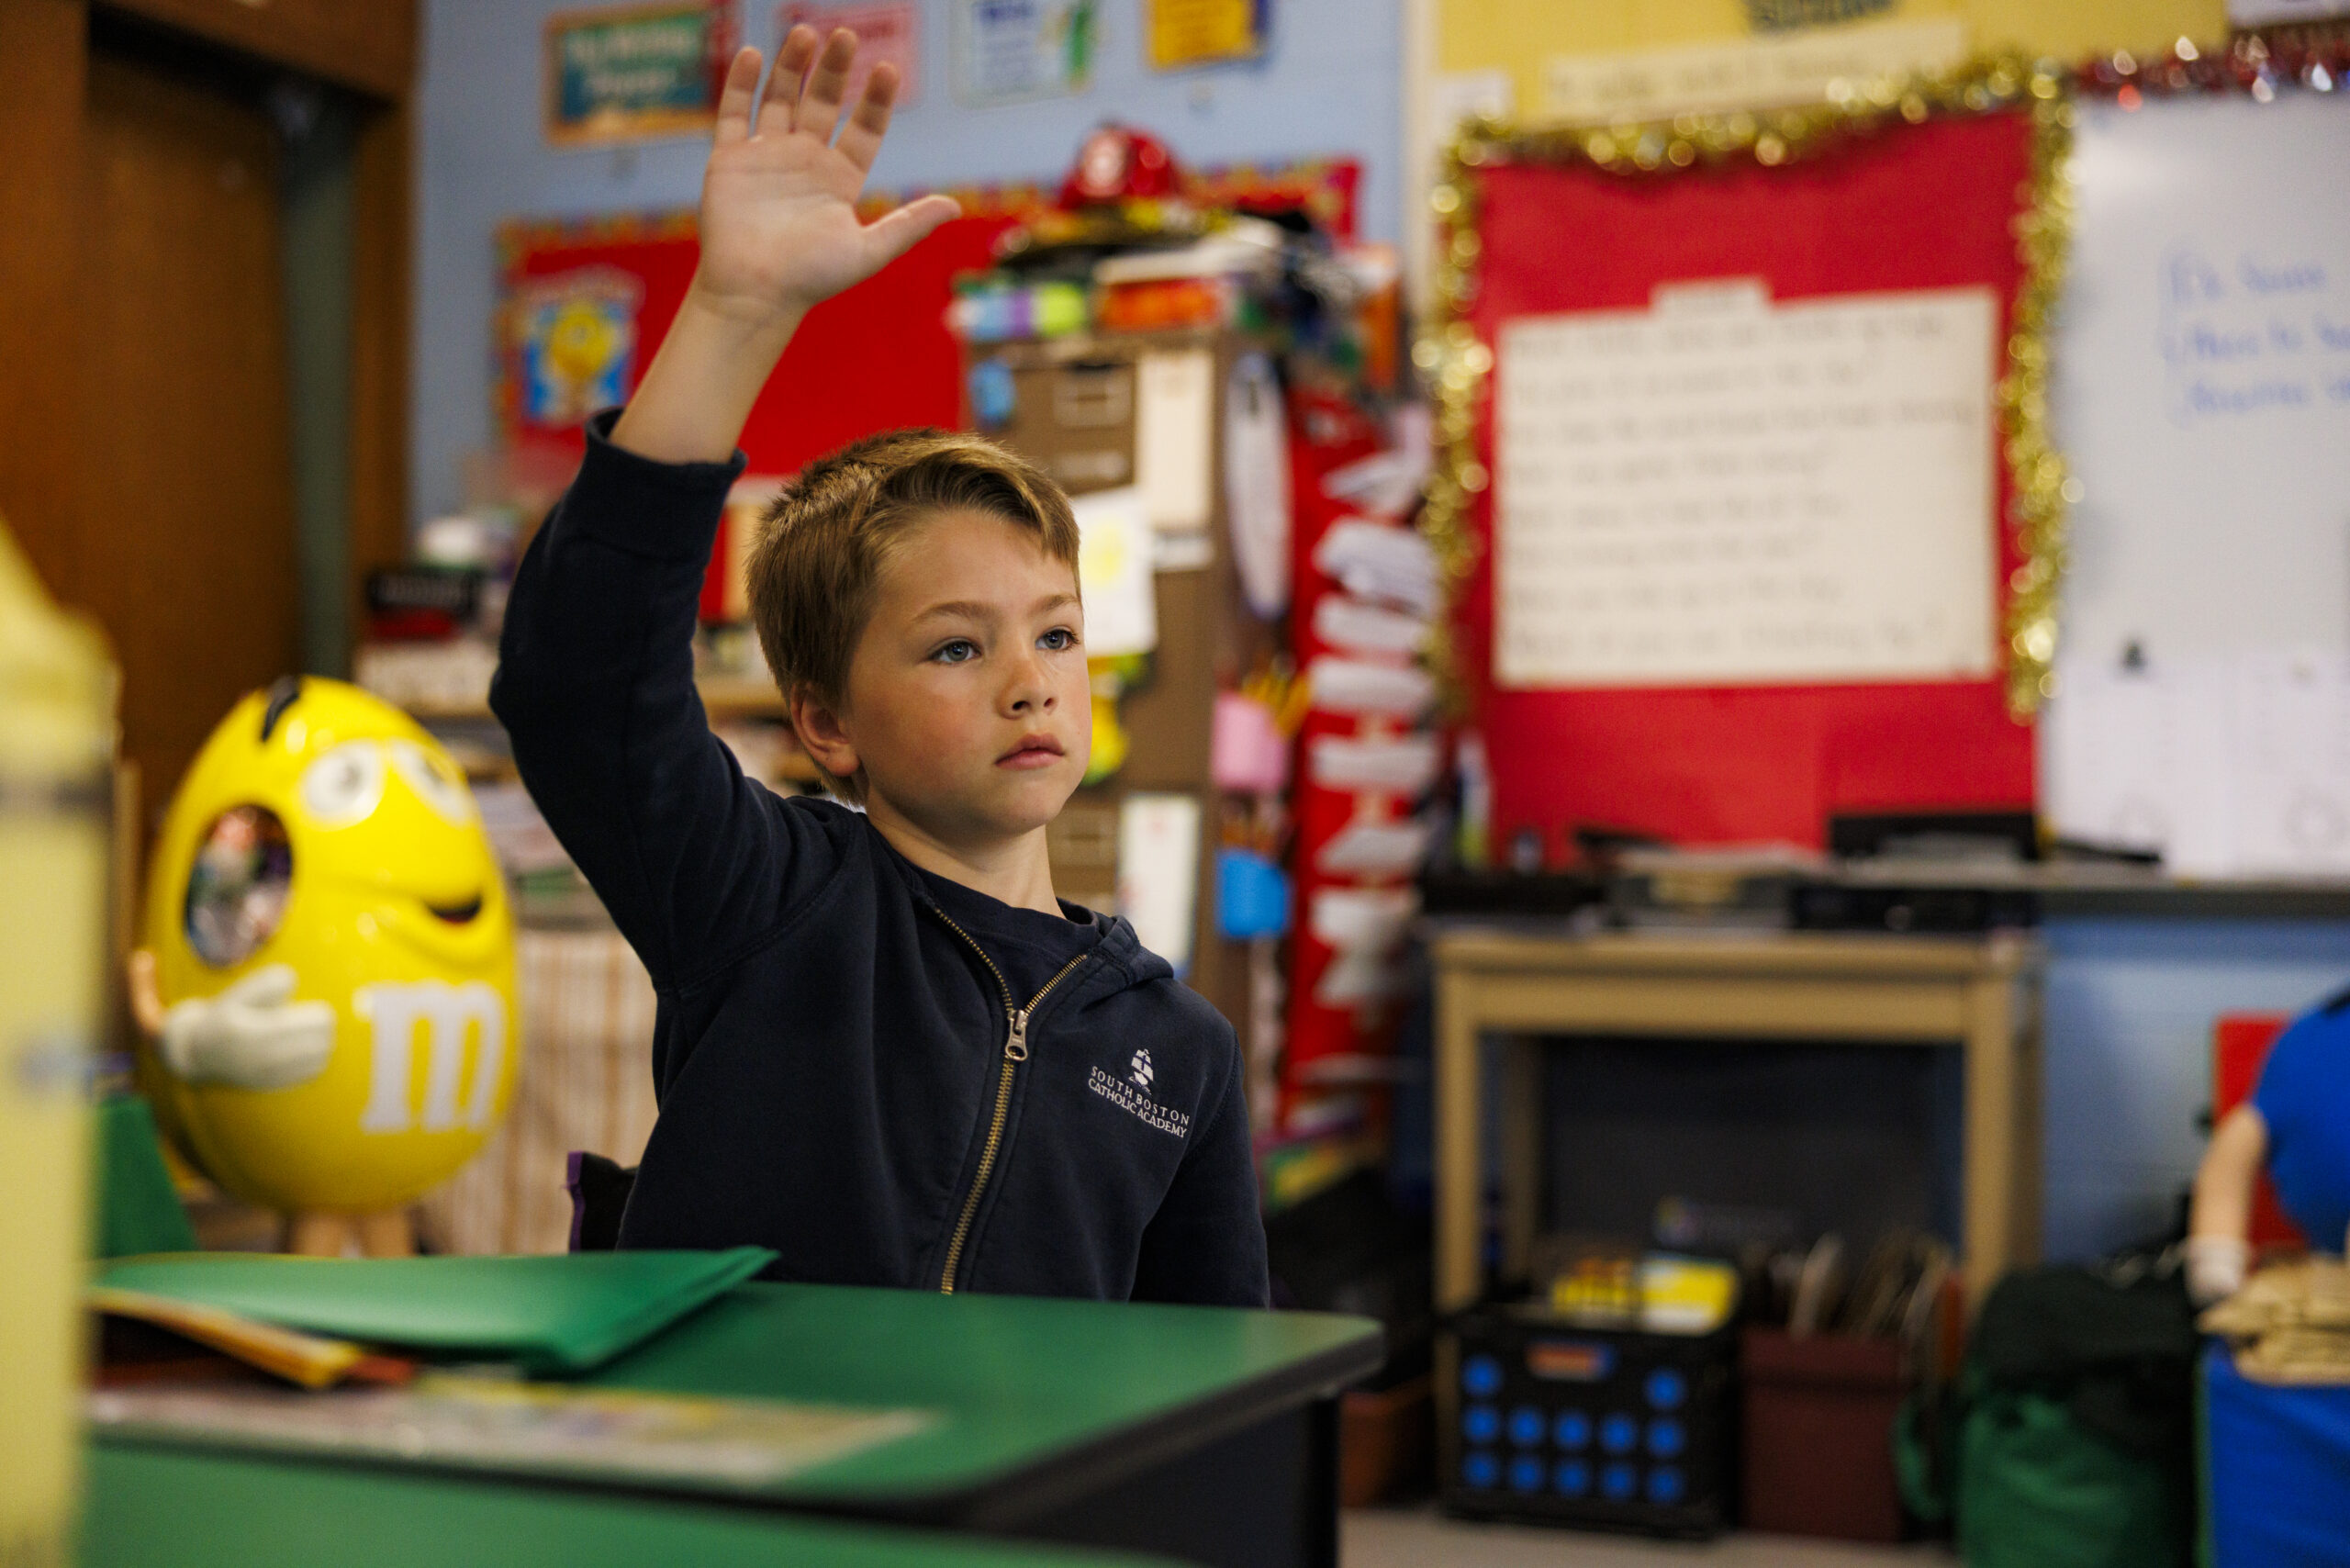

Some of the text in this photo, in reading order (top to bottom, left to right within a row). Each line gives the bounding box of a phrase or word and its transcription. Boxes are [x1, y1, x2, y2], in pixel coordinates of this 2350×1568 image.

[352, 981, 507, 1135] m
[1088, 1078, 1187, 1138] CATHOLIC ACADEMY
[1091, 1065, 1190, 1126] SOUTH BOSTON
